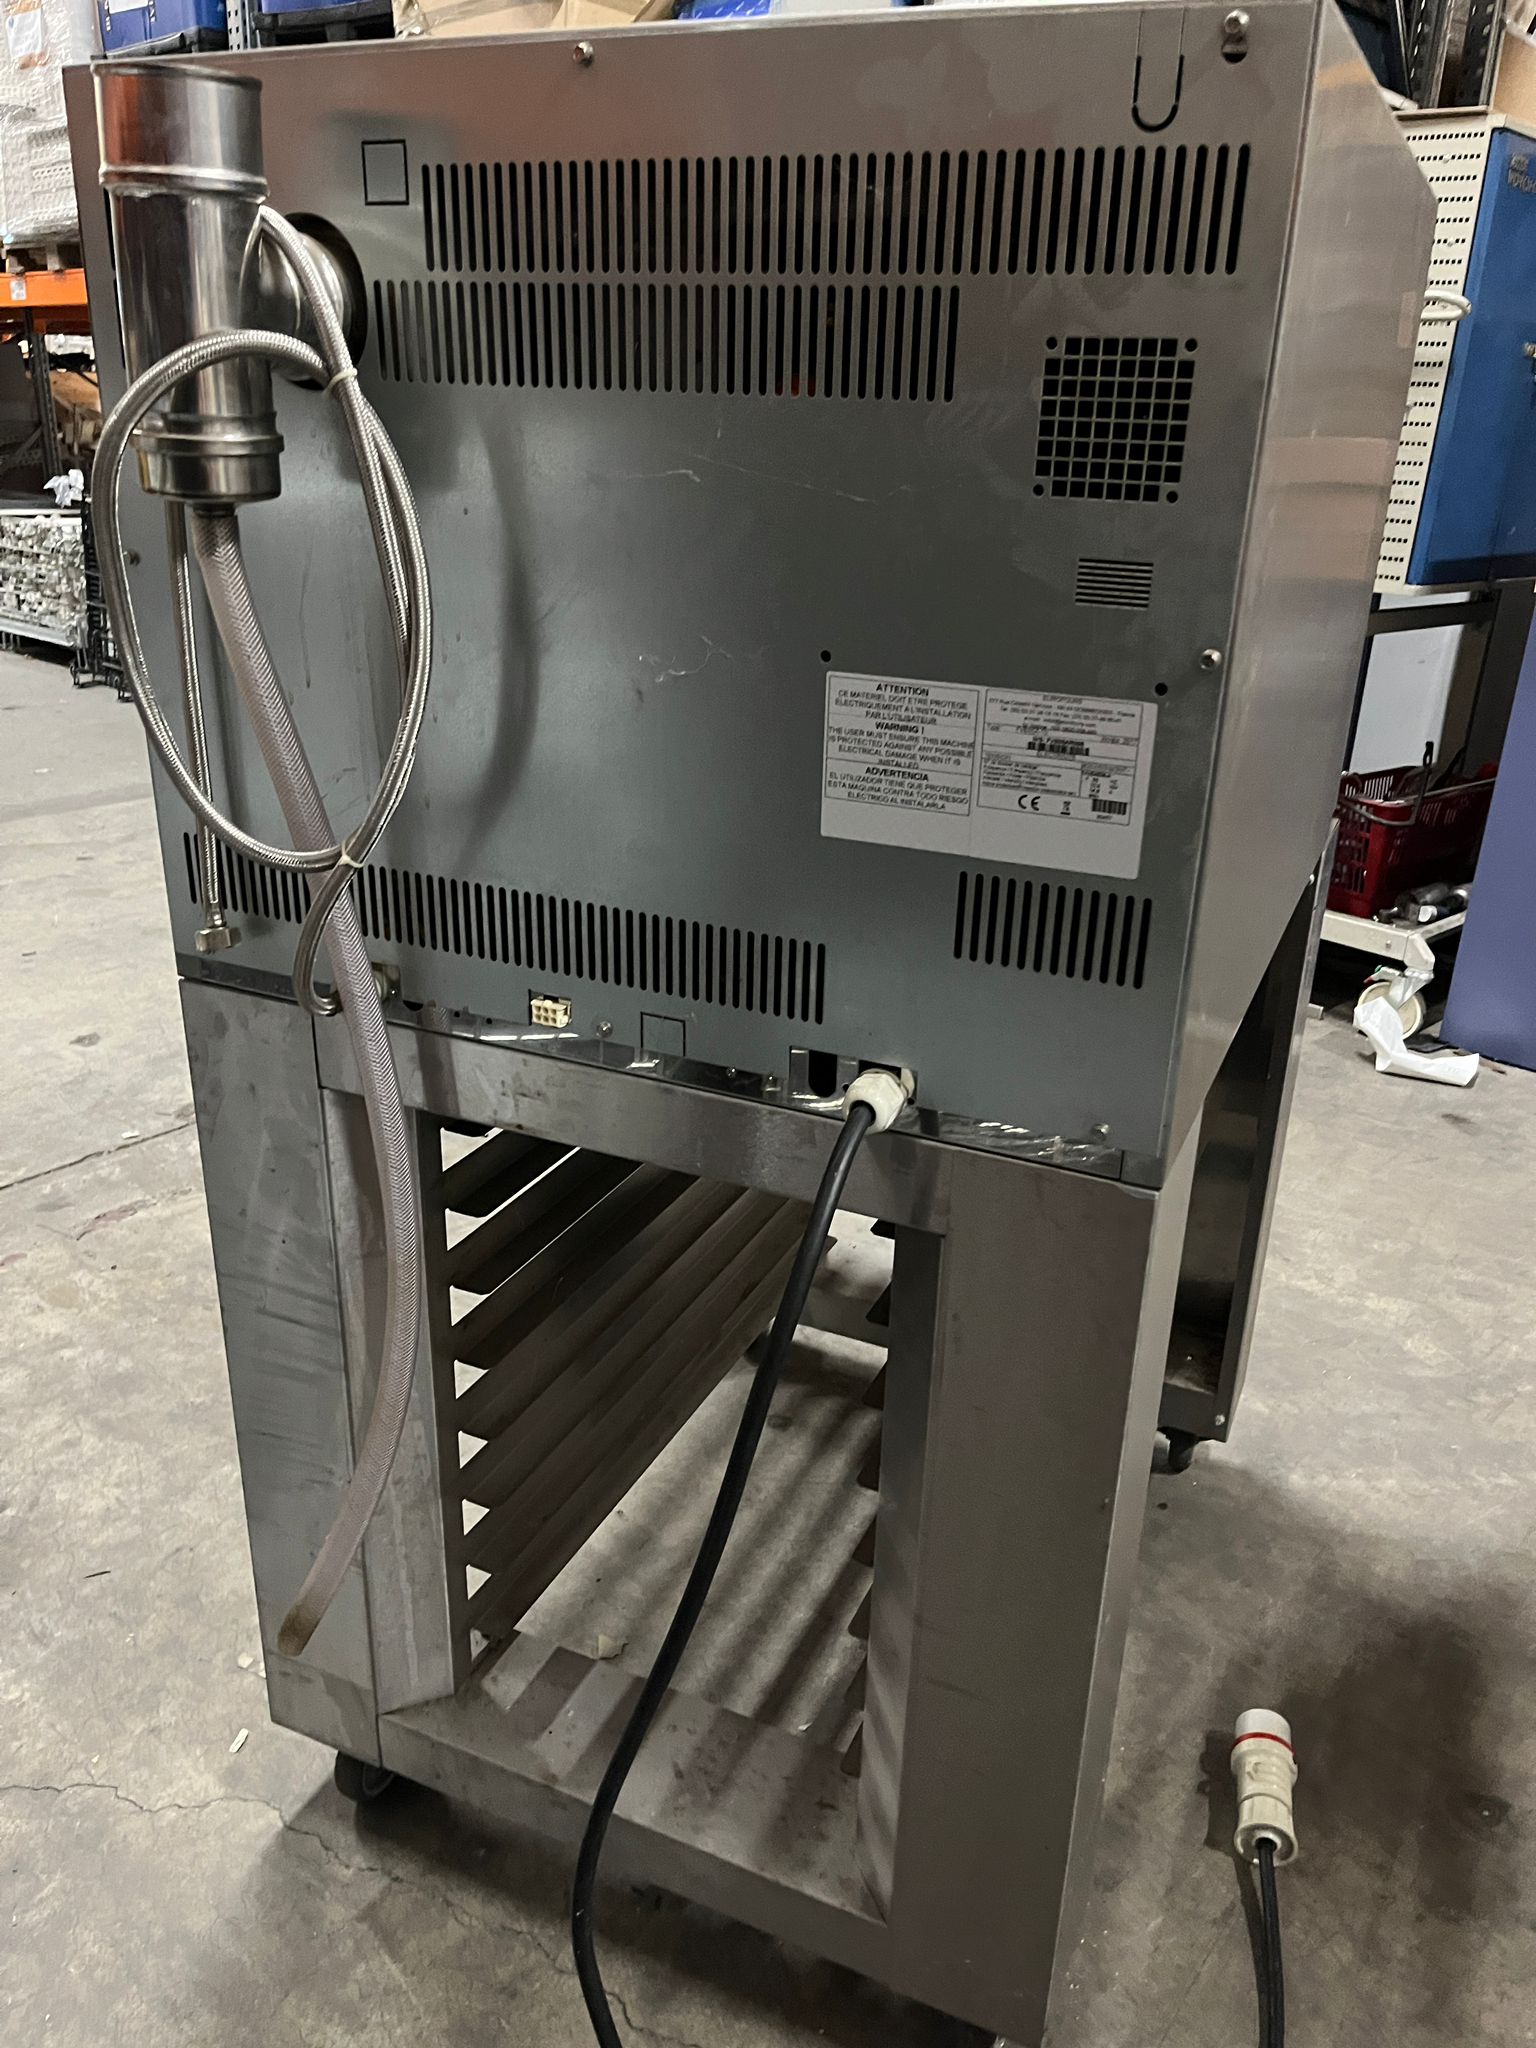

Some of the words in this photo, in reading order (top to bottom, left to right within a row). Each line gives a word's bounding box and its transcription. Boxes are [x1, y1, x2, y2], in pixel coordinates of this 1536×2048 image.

[876, 683, 929, 696] ATTENTION
[829, 726, 842, 735] THE
[844, 728, 864, 736] USER
[866, 730, 887, 739] MUST
[888, 732, 920, 743] ENSURE
[922, 736, 938, 746] THIS
[875, 721, 919, 734] WARNING
[837, 736, 882, 748] PROTECTED
[884, 742, 916, 750] AGAINST
[918, 745, 933, 754] ANY
[935, 747, 972, 758] POSSIBLE
[838, 744, 884, 756] ELECTRICAL
[885, 750, 917, 760] DAMAGE
[919, 754, 943, 764] WHEN
[878, 758, 919, 770] INSTALLED
[865, 766, 928, 782] ADVERTENCIA
[828, 780, 846, 788] ESTA
[848, 783, 881, 793] MAQUINA
[883, 787, 914, 797] CONTRA
[916, 791, 938, 800] TODO
[884, 778, 906, 788] TIENE
[907, 781, 924, 790] QUE
[925, 784, 968, 795] PROTEGER
